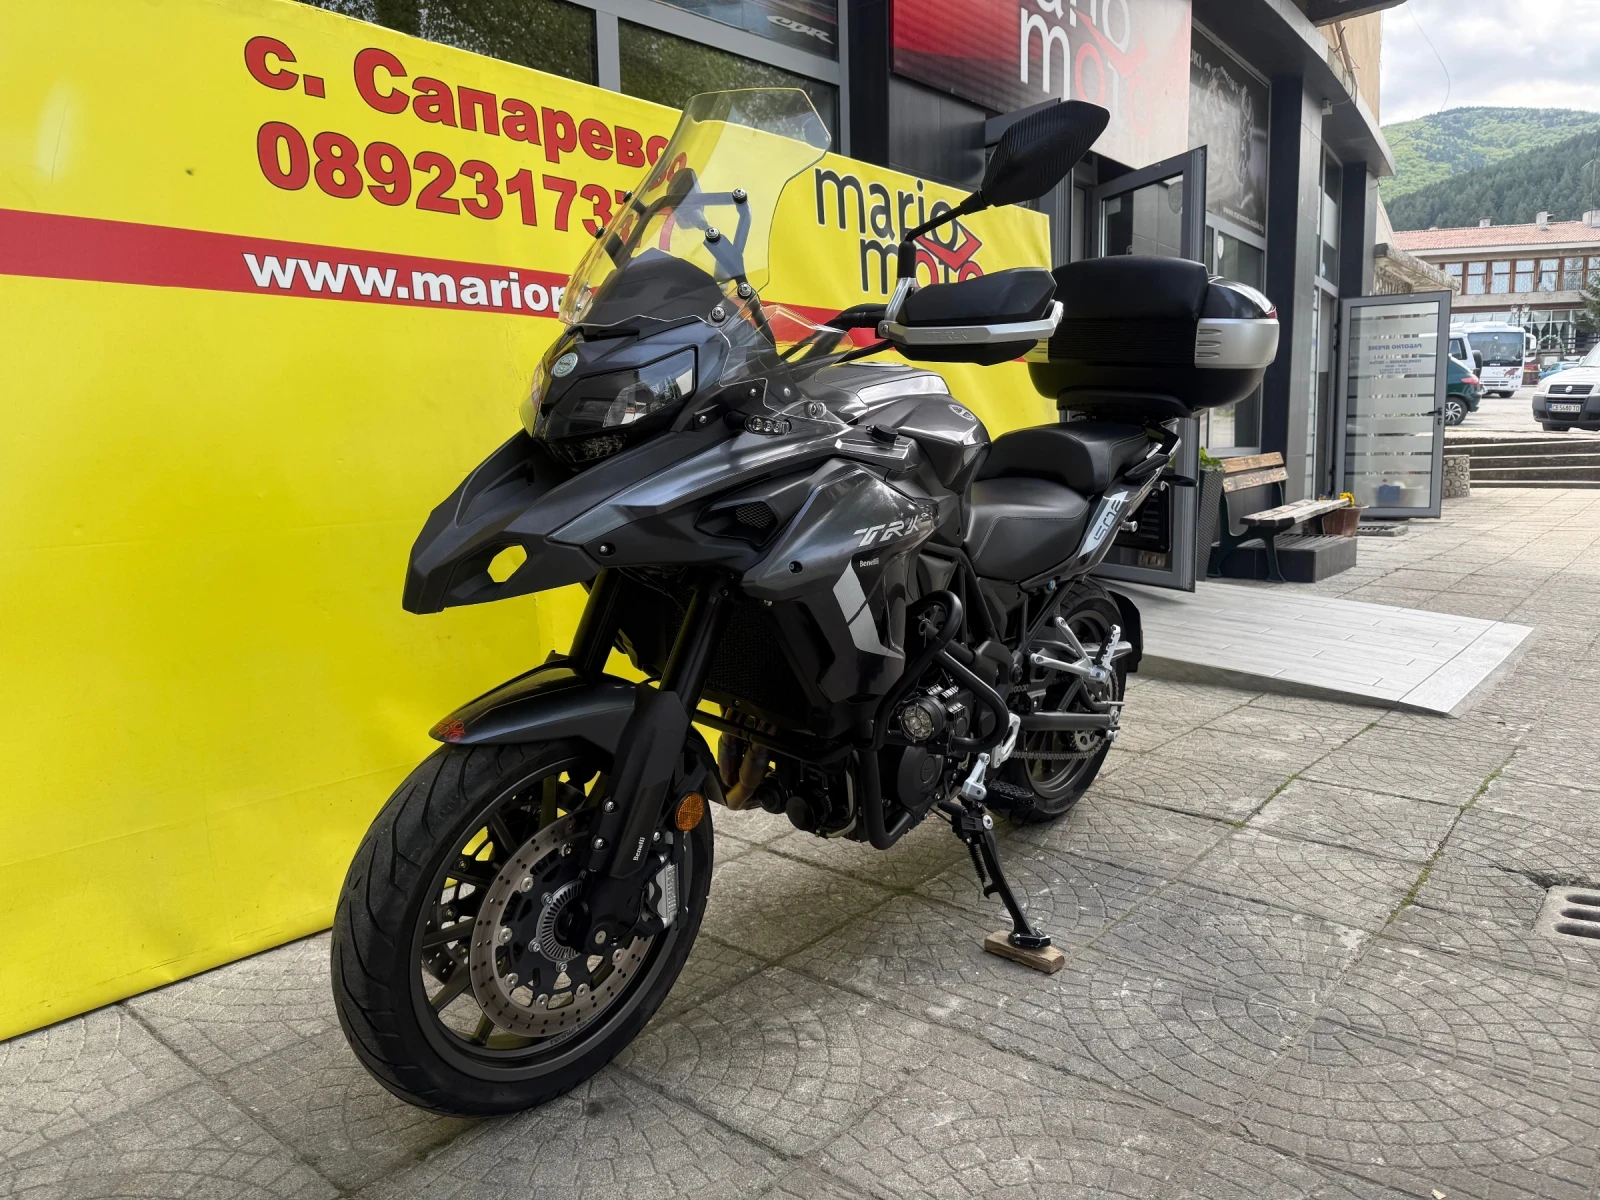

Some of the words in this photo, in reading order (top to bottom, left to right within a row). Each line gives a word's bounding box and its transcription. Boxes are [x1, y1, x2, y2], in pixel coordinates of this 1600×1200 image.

[766, 15, 834, 45] CBR
[244, 36, 326, 99] с.
[814, 167, 958, 251] mario
[853, 515, 919, 547] TRK
[1093, 499, 1121, 541] 502
[859, 557, 880, 568] Benelli
[632, 836, 646, 861] Benelli
